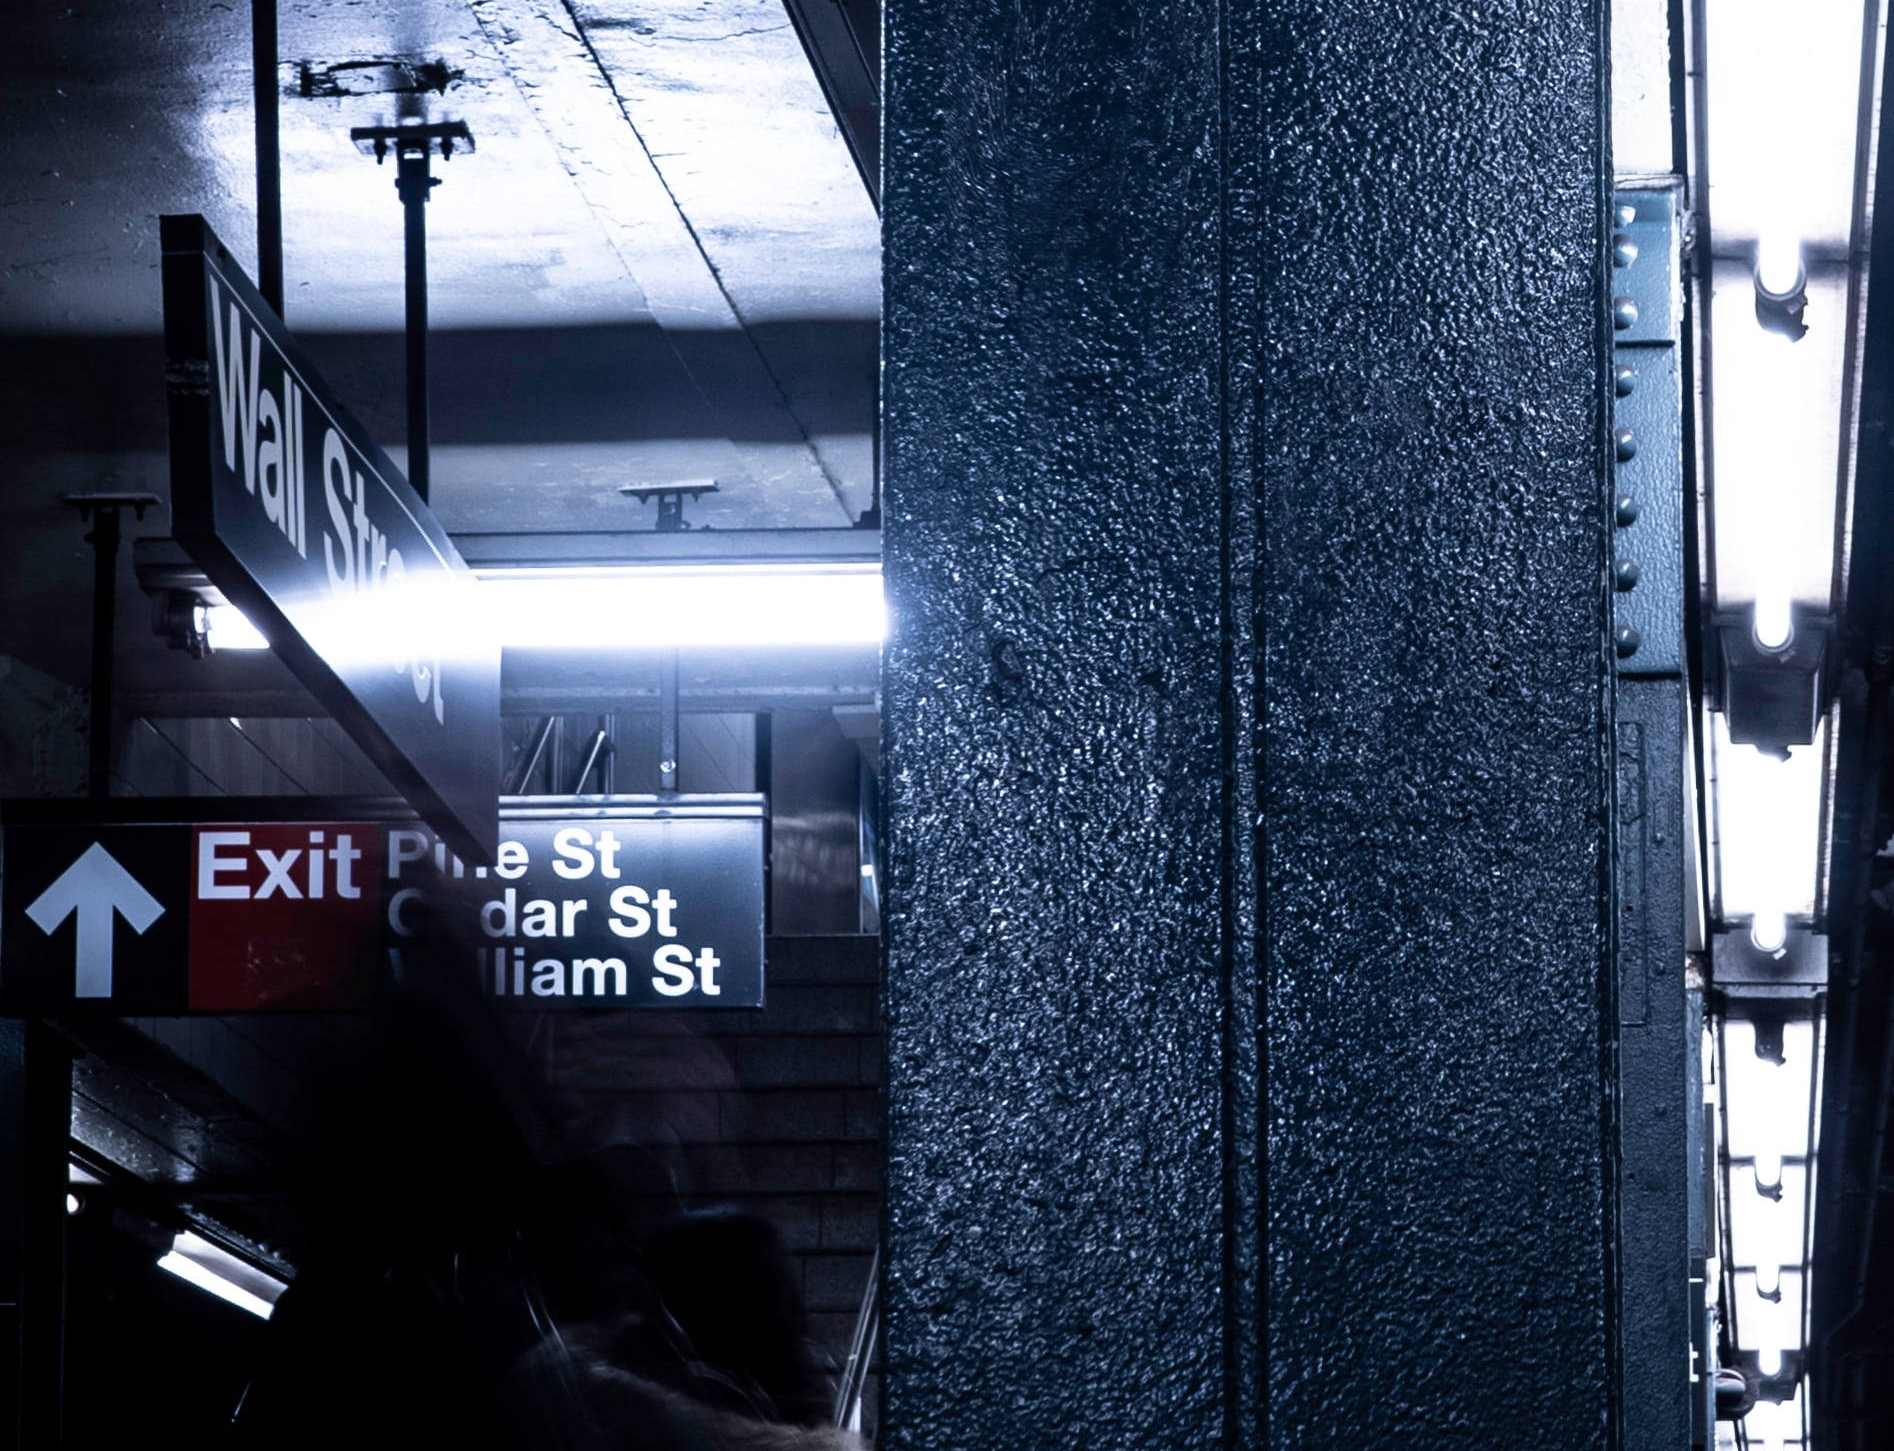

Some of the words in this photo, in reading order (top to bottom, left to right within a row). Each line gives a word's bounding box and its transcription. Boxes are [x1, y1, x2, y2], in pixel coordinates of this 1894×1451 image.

[209, 274, 307, 559] Wall
[198, 830, 362, 900] Exit
[552, 827, 622, 880] St
[387, 887, 588, 938] Cdar
[608, 885, 678, 938] St
[651, 943, 721, 997] St
